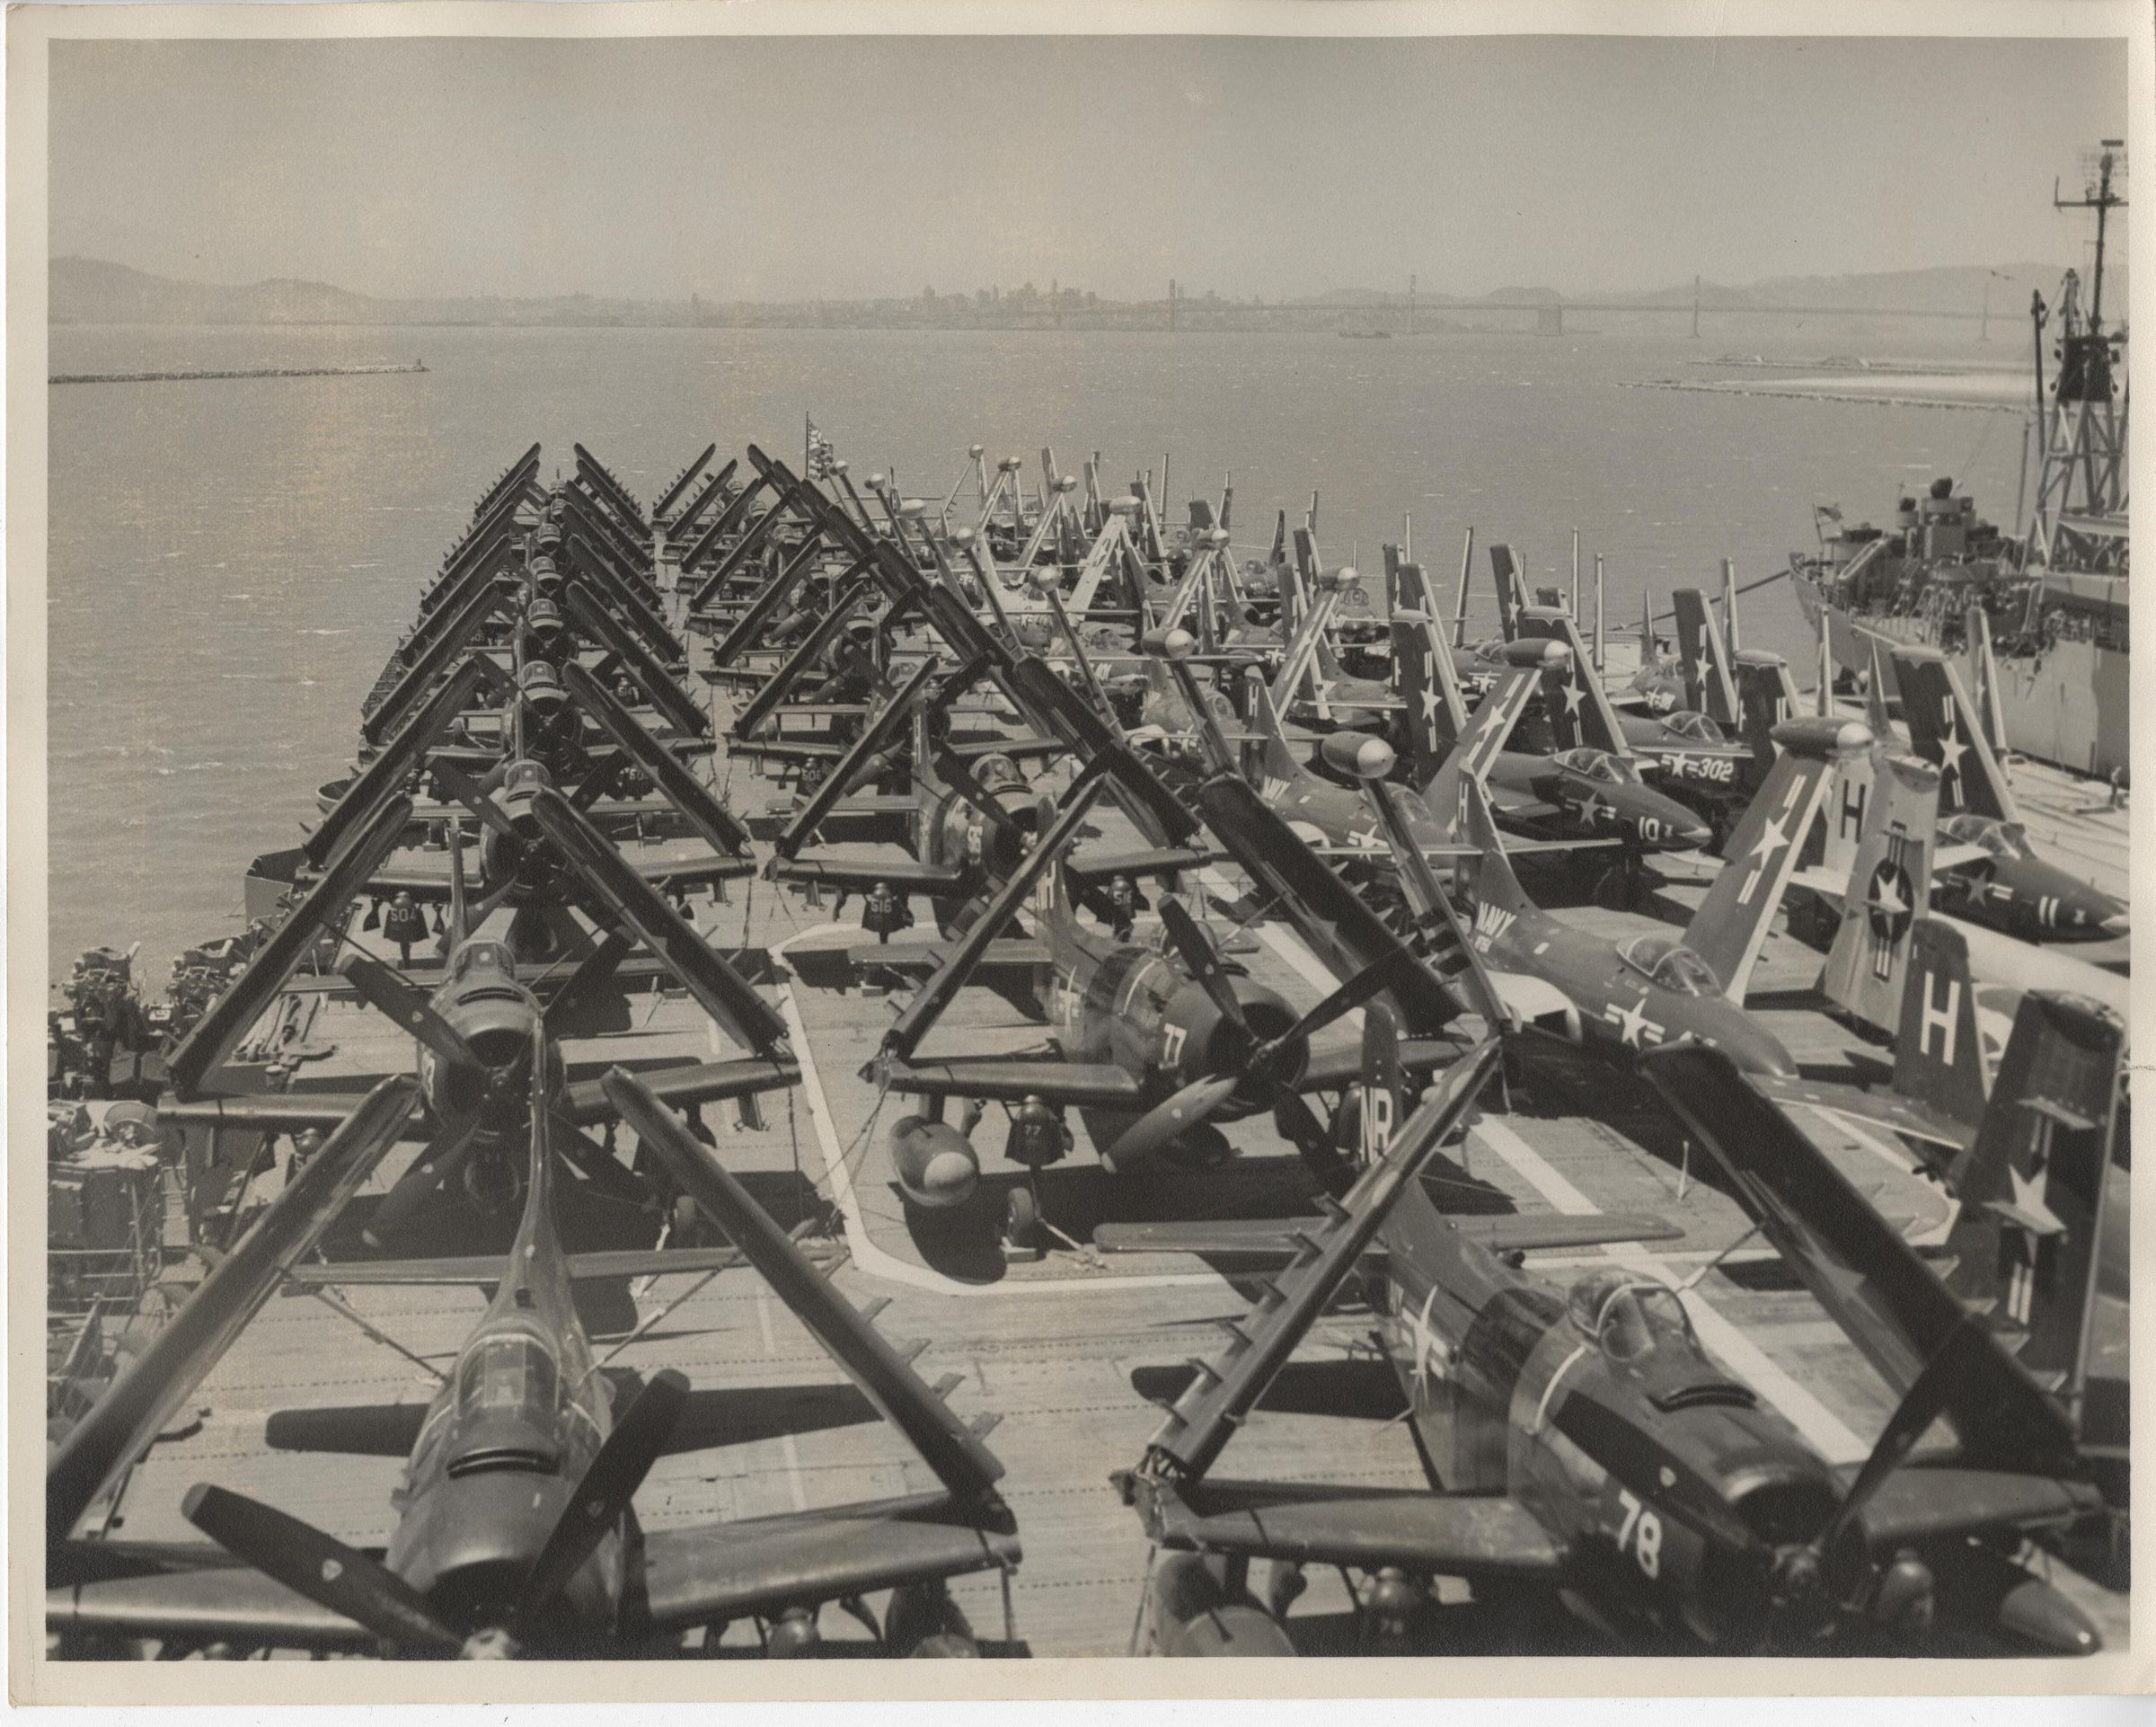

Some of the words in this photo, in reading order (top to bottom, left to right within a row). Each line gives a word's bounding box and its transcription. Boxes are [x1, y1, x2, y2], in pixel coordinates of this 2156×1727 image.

[1249, 686, 1259, 718] H
[1699, 757, 1734, 782] 302
[1459, 781, 1469, 824] H
[1841, 779, 1866, 844] H
[1639, 816, 1660, 842] 10
[870, 899, 892, 913] 516
[1476, 901, 1517, 939] NAVY
[2039, 896, 2059, 927] 11
[1920, 970, 1961, 1066] H
[1163, 1023, 1187, 1069] 77
[1361, 1086, 1392, 1166] NR
[1619, 1489, 1662, 1580] 78
